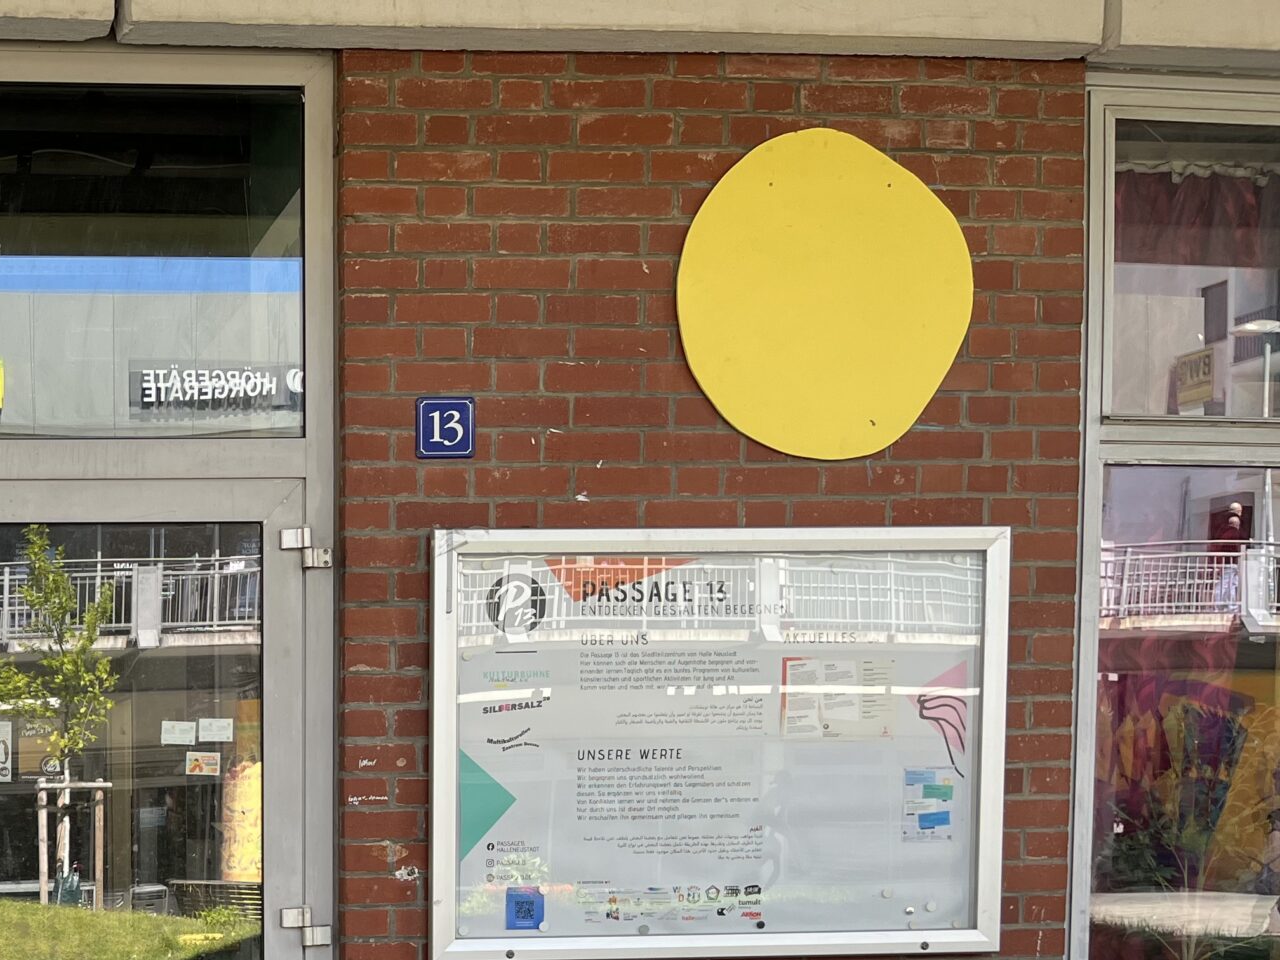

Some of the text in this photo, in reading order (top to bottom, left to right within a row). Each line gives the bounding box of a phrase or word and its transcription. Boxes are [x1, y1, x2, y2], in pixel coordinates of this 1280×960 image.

[428, 410, 464, 446] 13
[582, 580, 728, 603] PASSAGE 13
[580, 604, 647, 616] ENTDECKEN
[653, 604, 719, 616] GESTALTEN
[620, 633, 649, 645] UNS
[783, 631, 857, 643] AKTUELLES
[482, 700, 543, 714] SILBERSALZ
[577, 748, 683, 761] UNSERE WERTE
[738, 898, 762, 906] tumult
